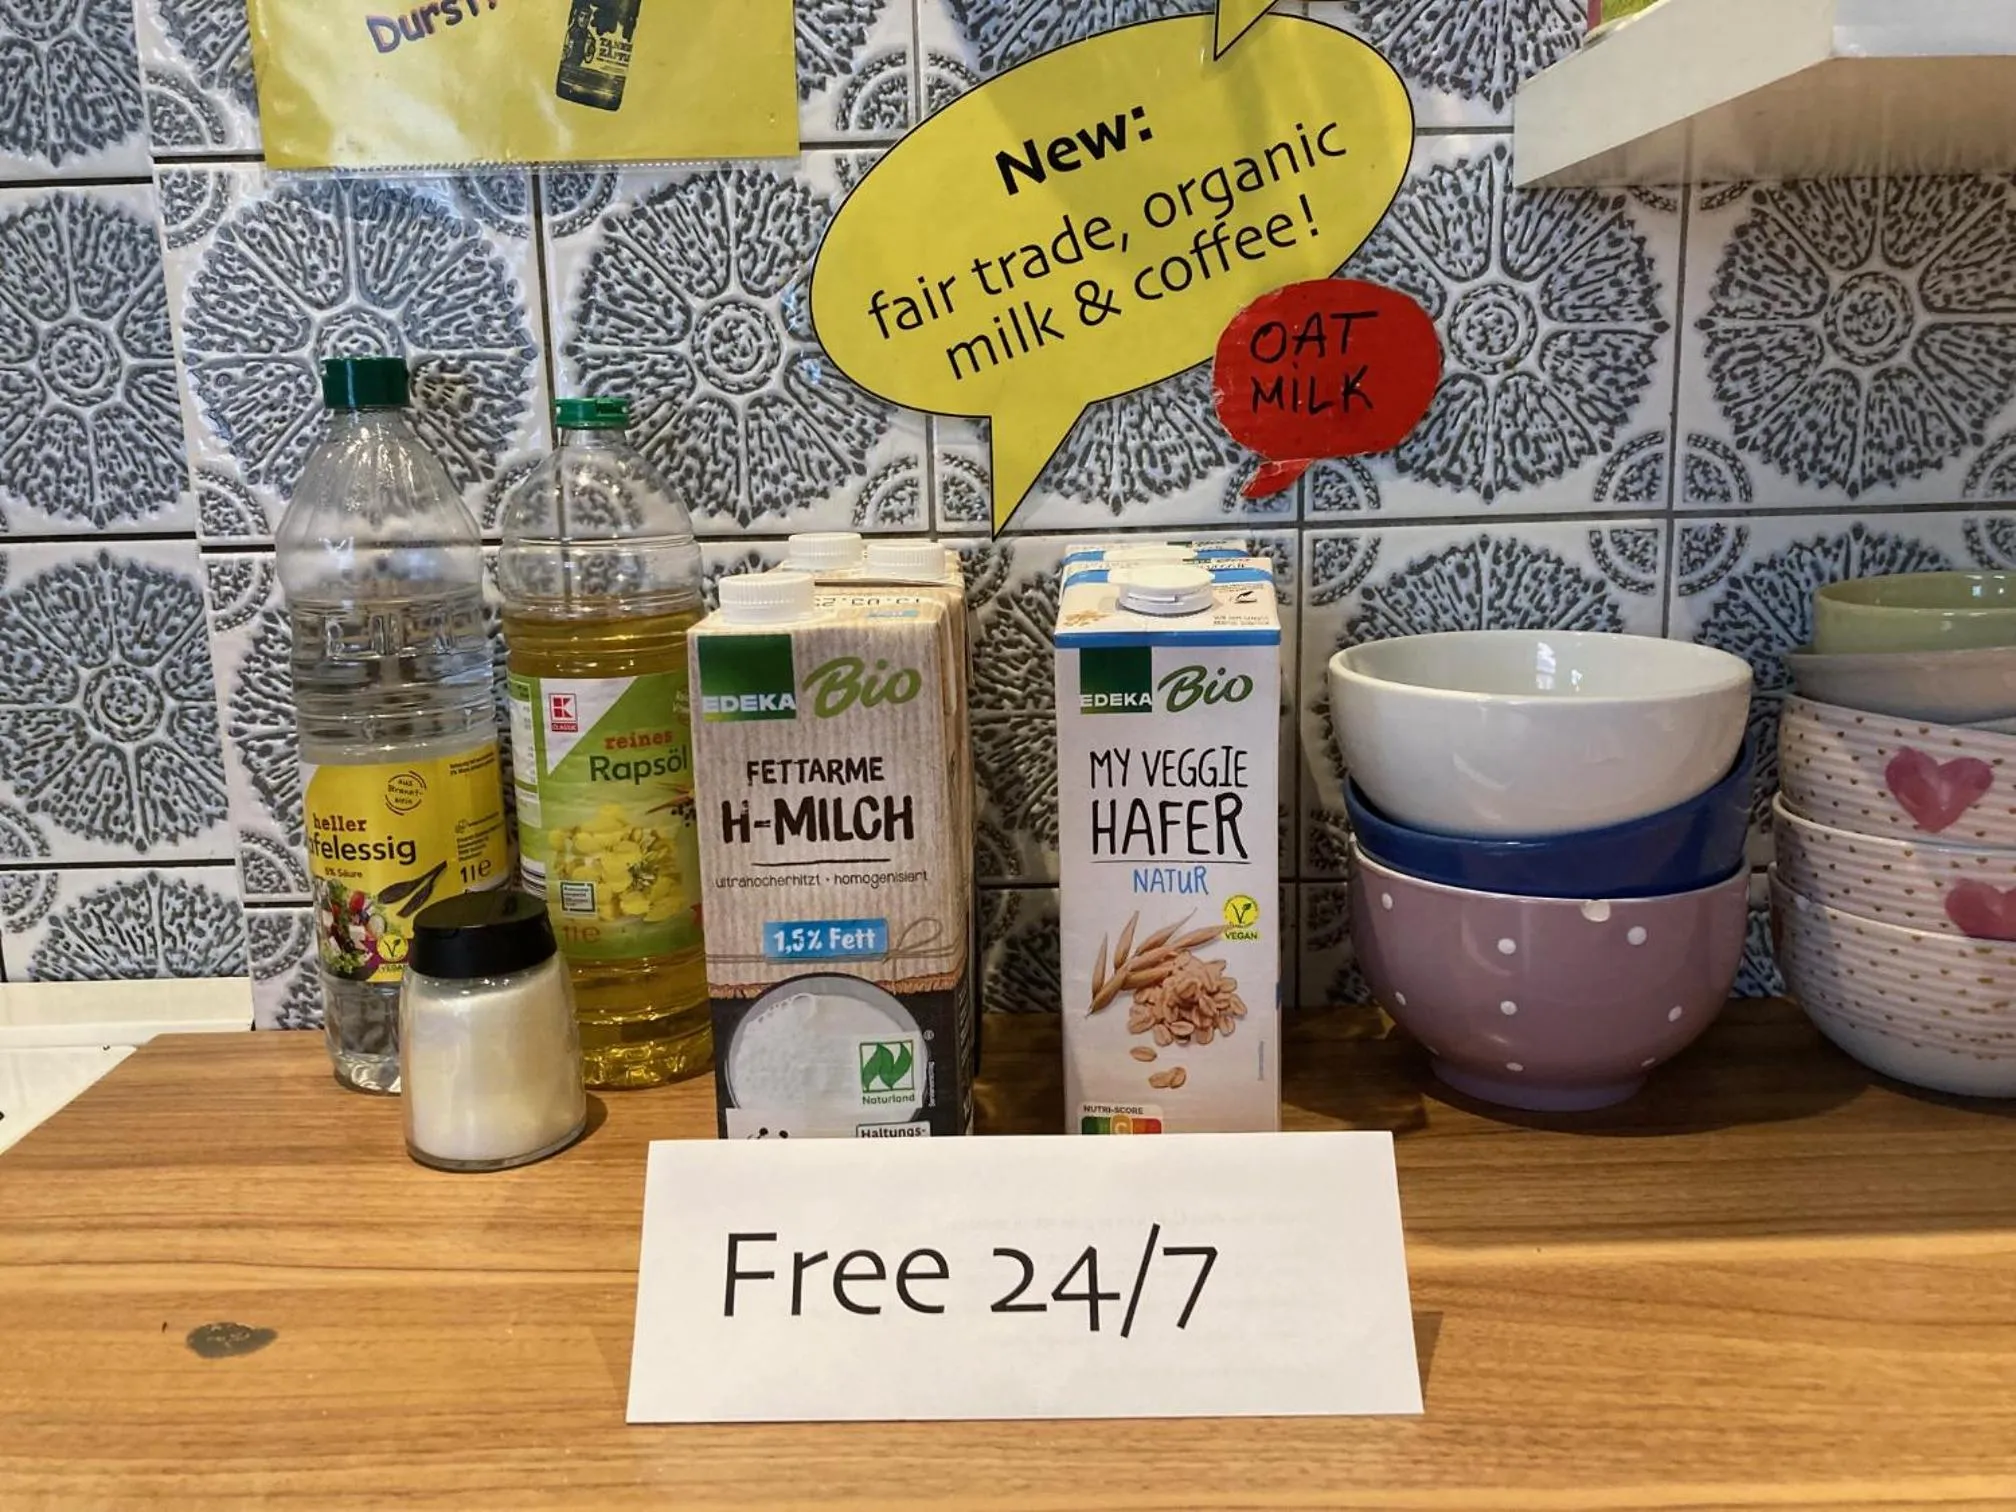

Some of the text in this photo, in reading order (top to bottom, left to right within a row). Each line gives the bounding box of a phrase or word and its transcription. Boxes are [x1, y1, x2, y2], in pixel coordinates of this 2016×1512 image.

[995, 105, 1153, 195] New:
[869, 122, 1347, 339] fair trade, organic
[946, 195, 1320, 379] milk & coffee!
[1249, 311, 1379, 364] OAT
[702, 693, 796, 714] EDEKA
[803, 656, 922, 719] Bio
[1081, 664, 1253, 713] EDEKA Bio
[604, 730, 673, 751] reines
[589, 744, 688, 786] Rapsöl
[746, 756, 885, 787] FETTARME
[1090, 745, 1249, 789] MY VEGGIE
[313, 812, 367, 832] heller
[721, 794, 915, 845] H-MILCH
[1092, 792, 1249, 860] HAFER
[309, 832, 417, 866] felessig
[834, 869, 929, 890] homogenisiert
[1133, 865, 1210, 896] NATUR
[773, 926, 876, 954] 1,5% Fett
[1224, 931, 1258, 940] VEGAN
[862, 1093, 916, 1104] Naturland
[1083, 1104, 1144, 1115] NUTRI-SCORE
[860, 1126, 927, 1138] Haltungs-
[723, 1222, 1219, 1340] Free 24/7
